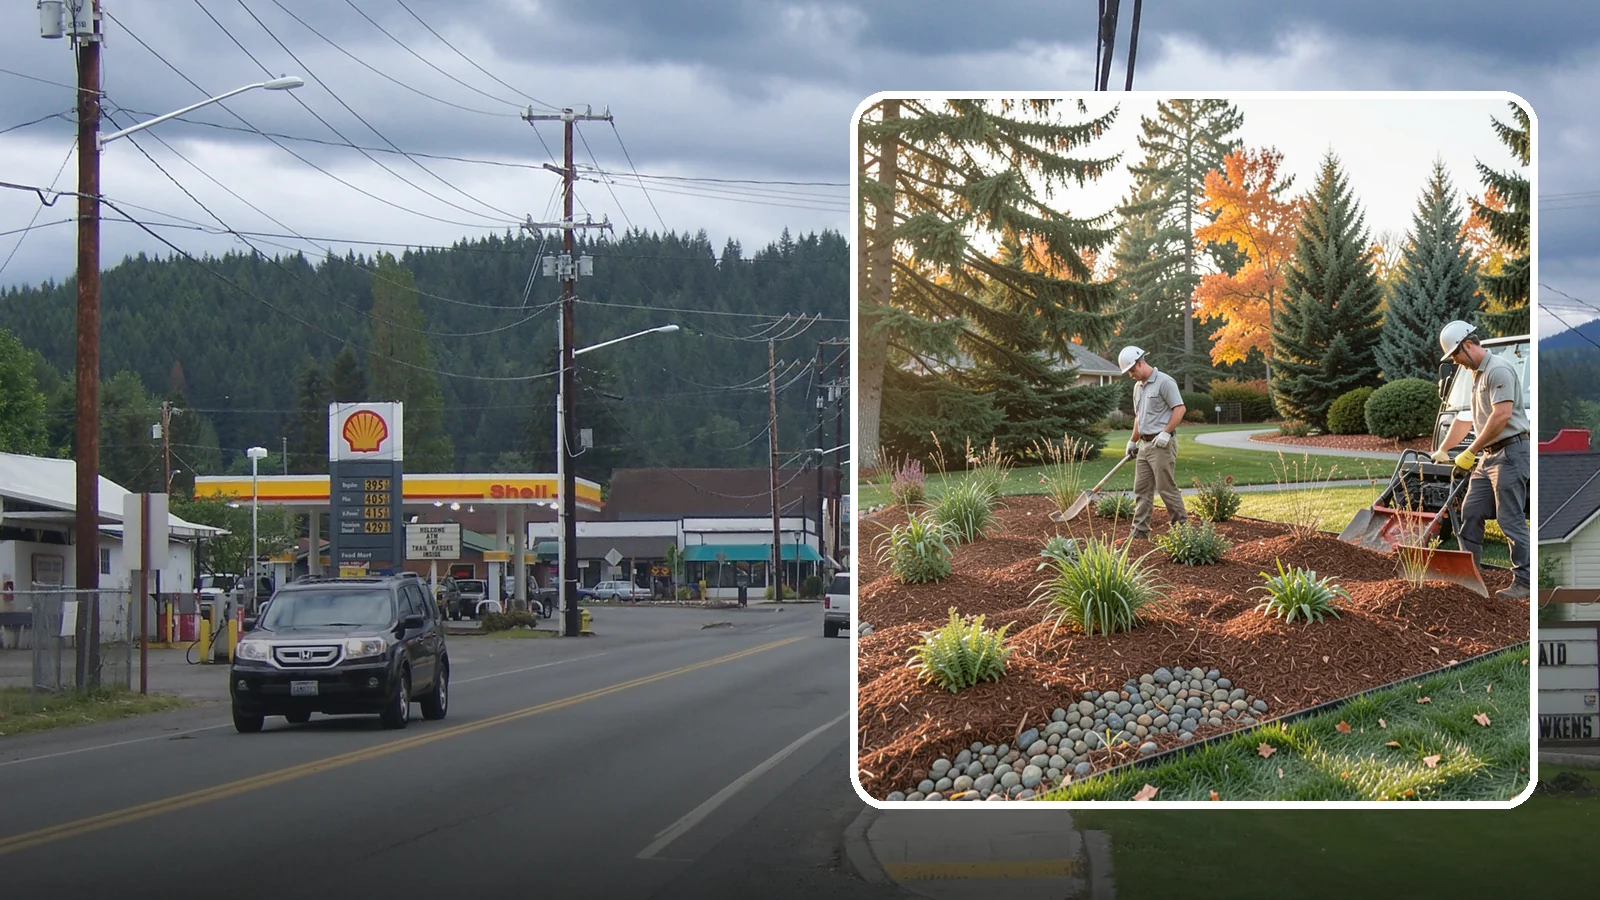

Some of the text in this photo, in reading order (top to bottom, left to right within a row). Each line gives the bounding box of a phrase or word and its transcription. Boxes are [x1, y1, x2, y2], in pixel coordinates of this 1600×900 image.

[366, 480, 383, 490] 395
[490, 484, 548, 499] Shell
[365, 495, 383, 504] 405
[365, 508, 383, 518] 415
[365, 523, 383, 533] 429
